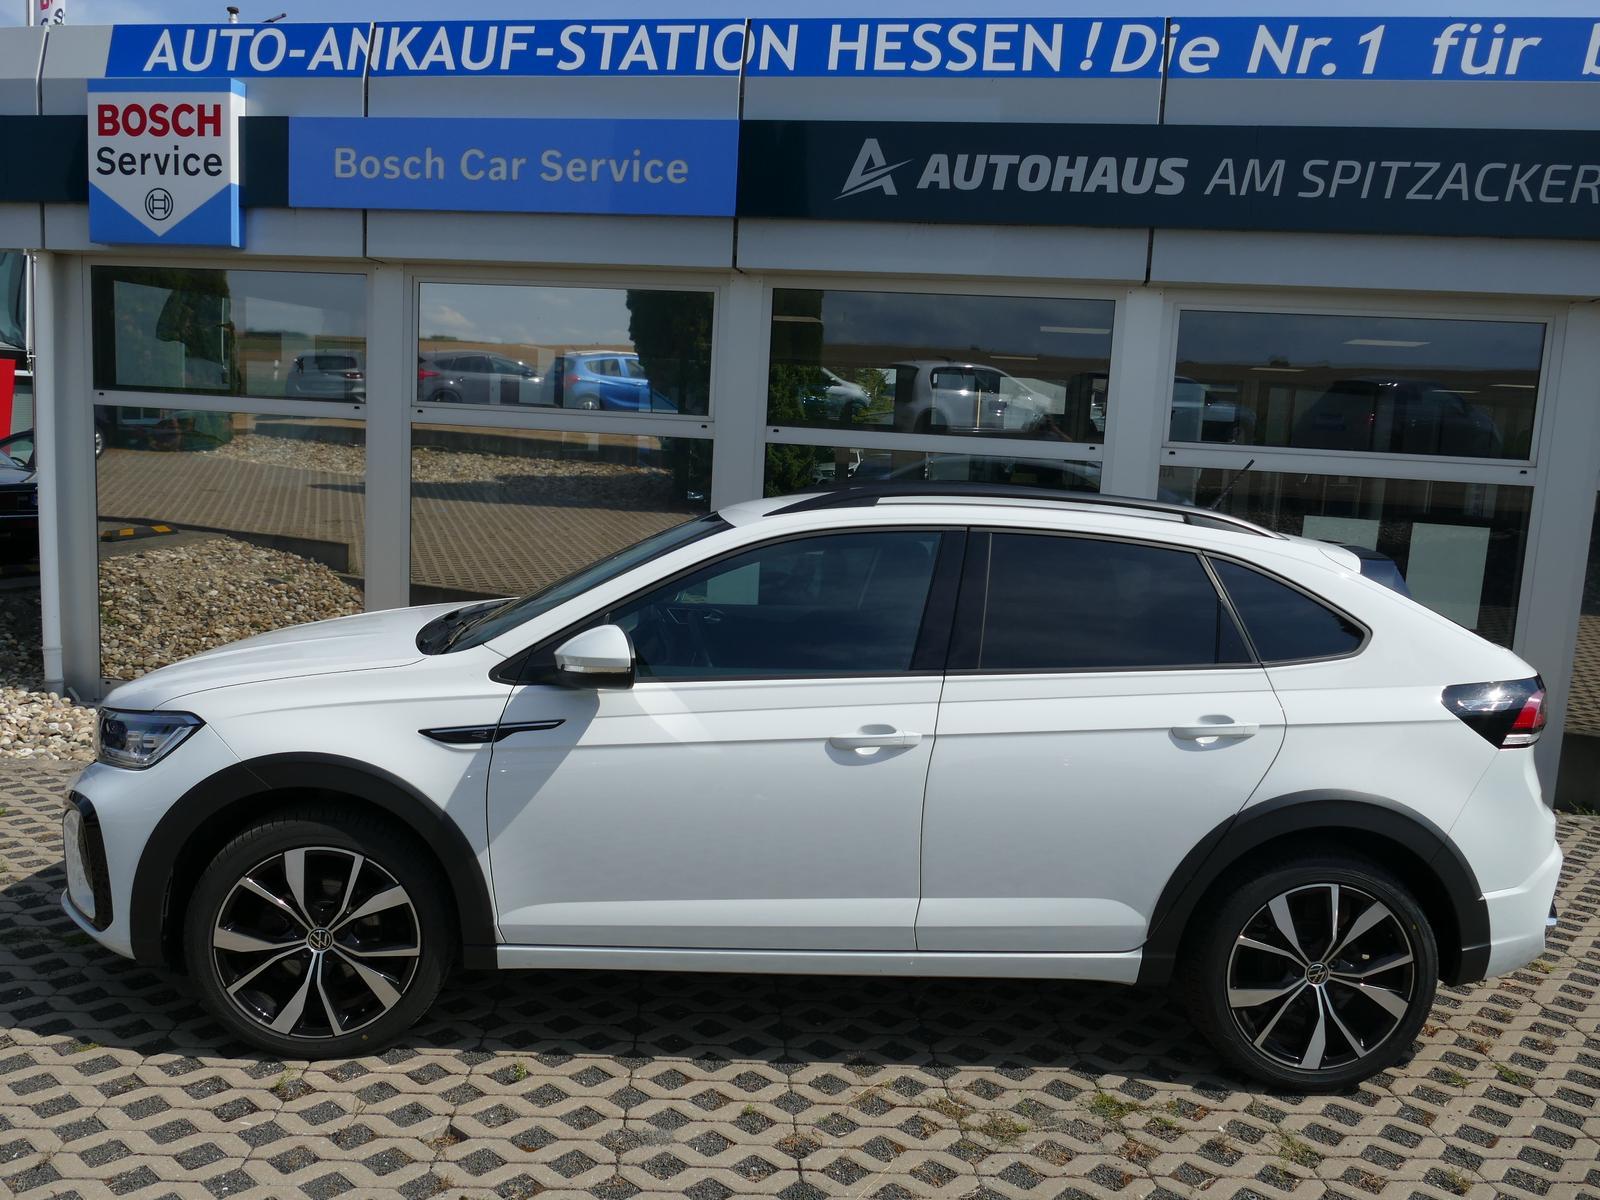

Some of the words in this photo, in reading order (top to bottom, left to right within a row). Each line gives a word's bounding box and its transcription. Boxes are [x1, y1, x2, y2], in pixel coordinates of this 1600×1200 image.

[1432, 23, 1542, 75] für
[98, 104, 221, 137] BOSCH
[96, 145, 222, 176] Service
[335, 147, 445, 180] Bosch
[460, 148, 527, 181] Car
[540, 149, 689, 184] Service
[916, 153, 1189, 195] AUTOHAUS
[1204, 158, 1286, 197] AM
[1298, 159, 1600, 204] SPITZACKER
